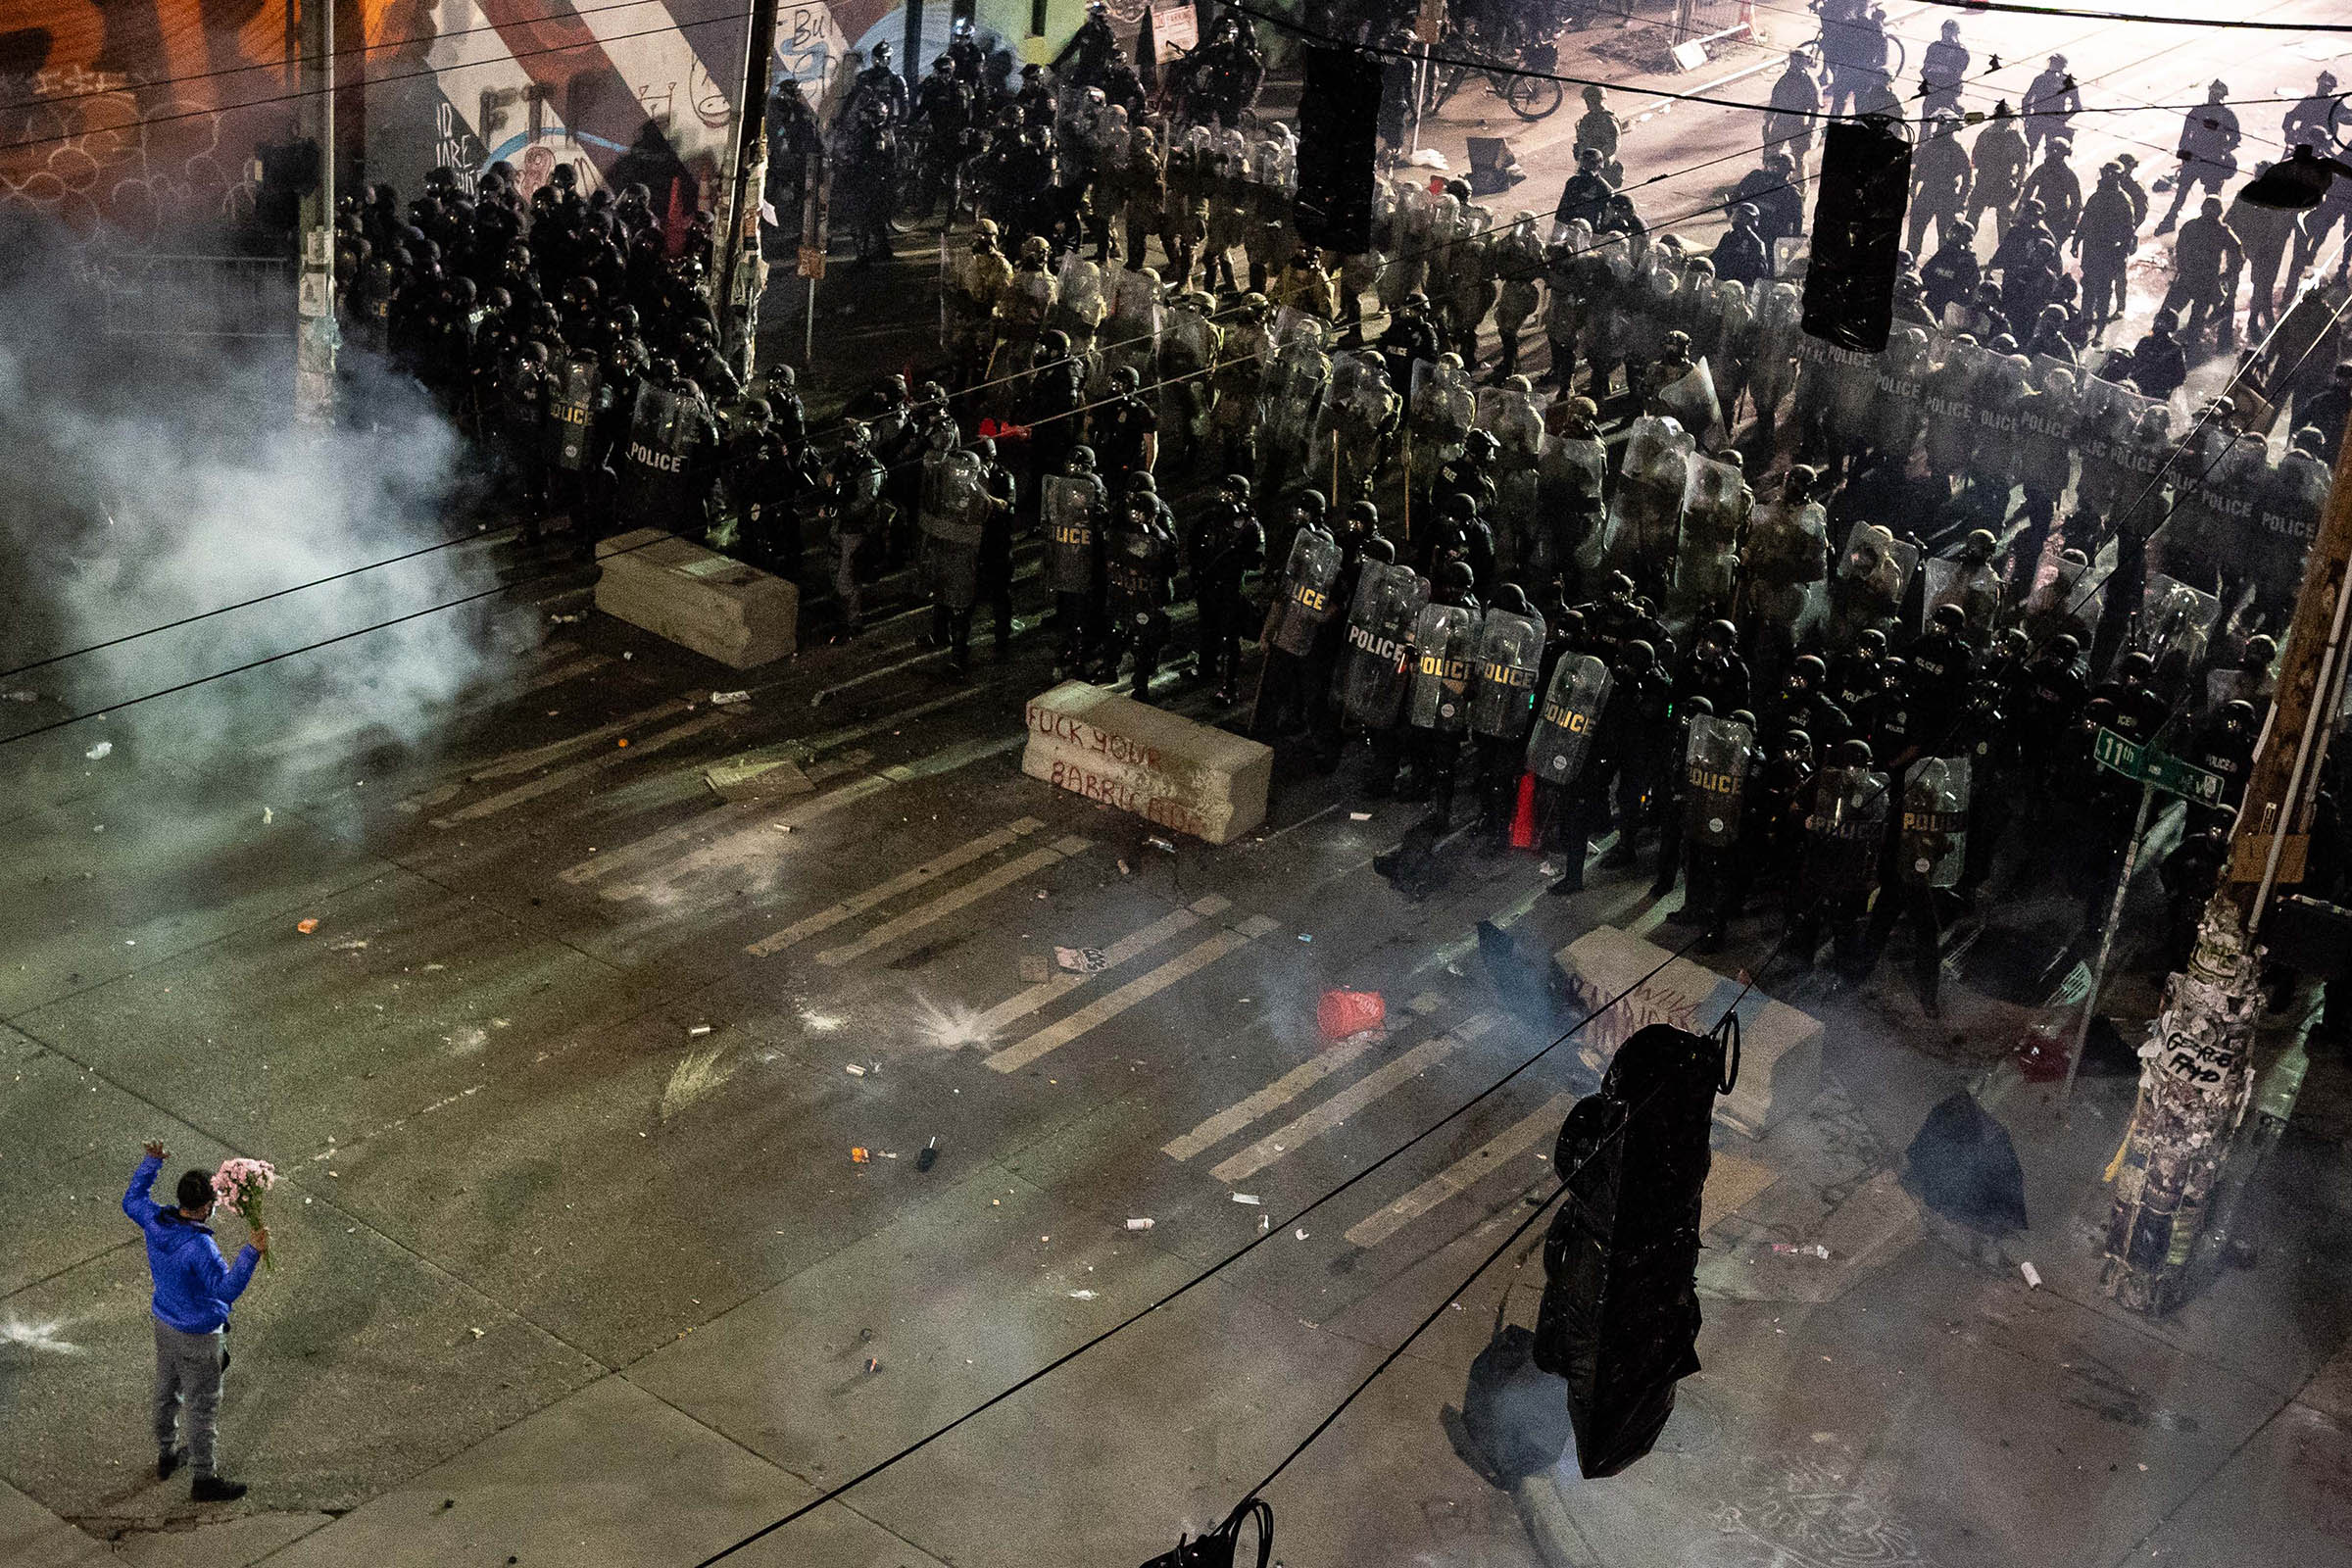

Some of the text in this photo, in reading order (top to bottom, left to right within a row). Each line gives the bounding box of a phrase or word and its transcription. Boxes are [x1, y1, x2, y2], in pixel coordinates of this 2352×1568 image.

[1828, 345, 1873, 369] POLICE
[1875, 374, 1922, 401] POLICE
[1924, 395, 1974, 420] POLICE
[2020, 410, 2073, 440] POLICE
[629, 441, 681, 473] POLICE
[2110, 446, 2156, 474] POLICE
[2203, 489, 2254, 518] POLICE
[2261, 512, 2316, 539] POLICE
[1348, 624, 1405, 662] POLICE
[1028, 706, 1163, 773] FUCK YOUR
[2104, 736, 2135, 767] 11th
[2167, 1032, 2232, 1068] GEORGE
